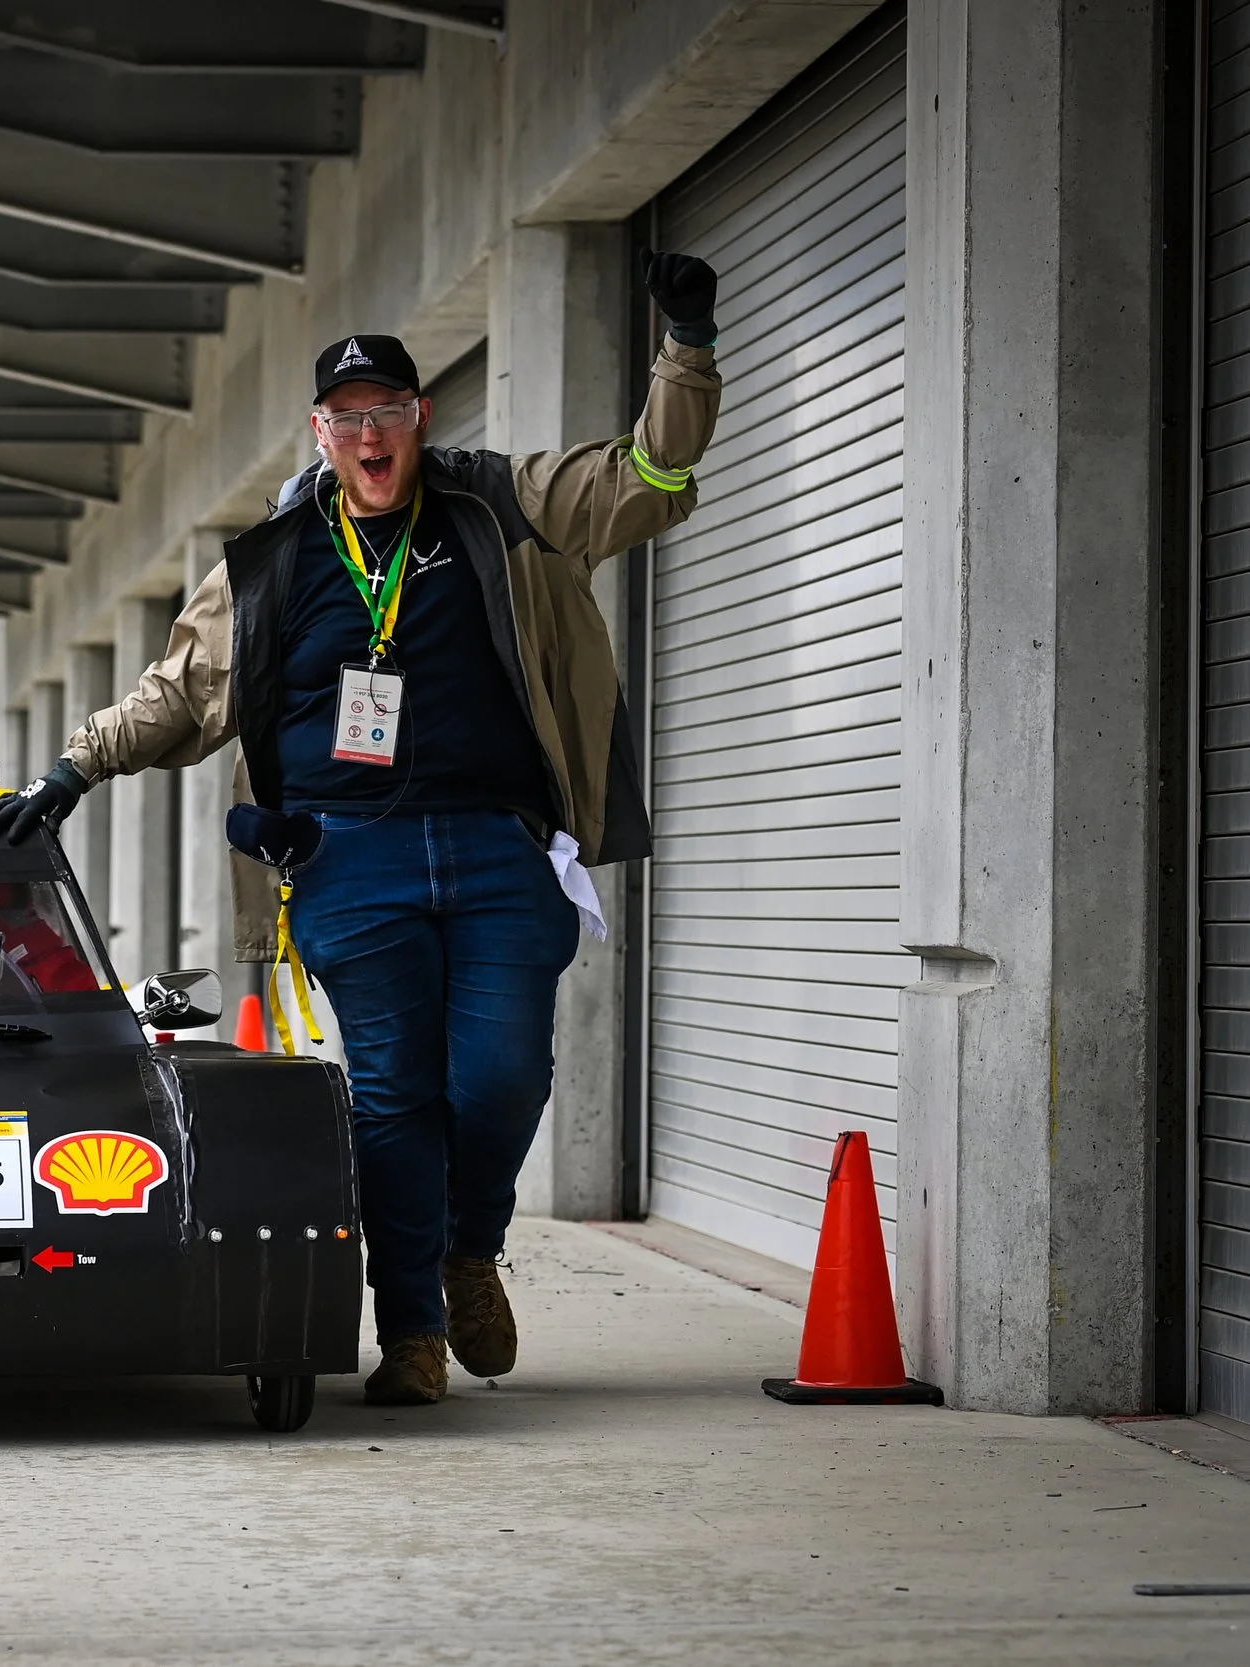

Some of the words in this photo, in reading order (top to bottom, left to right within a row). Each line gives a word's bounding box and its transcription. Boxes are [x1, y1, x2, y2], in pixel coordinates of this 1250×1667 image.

[417, 565, 429, 574] AIR
[429, 557, 452, 568] FORCE
[77, 1254, 97, 1264] Tow
